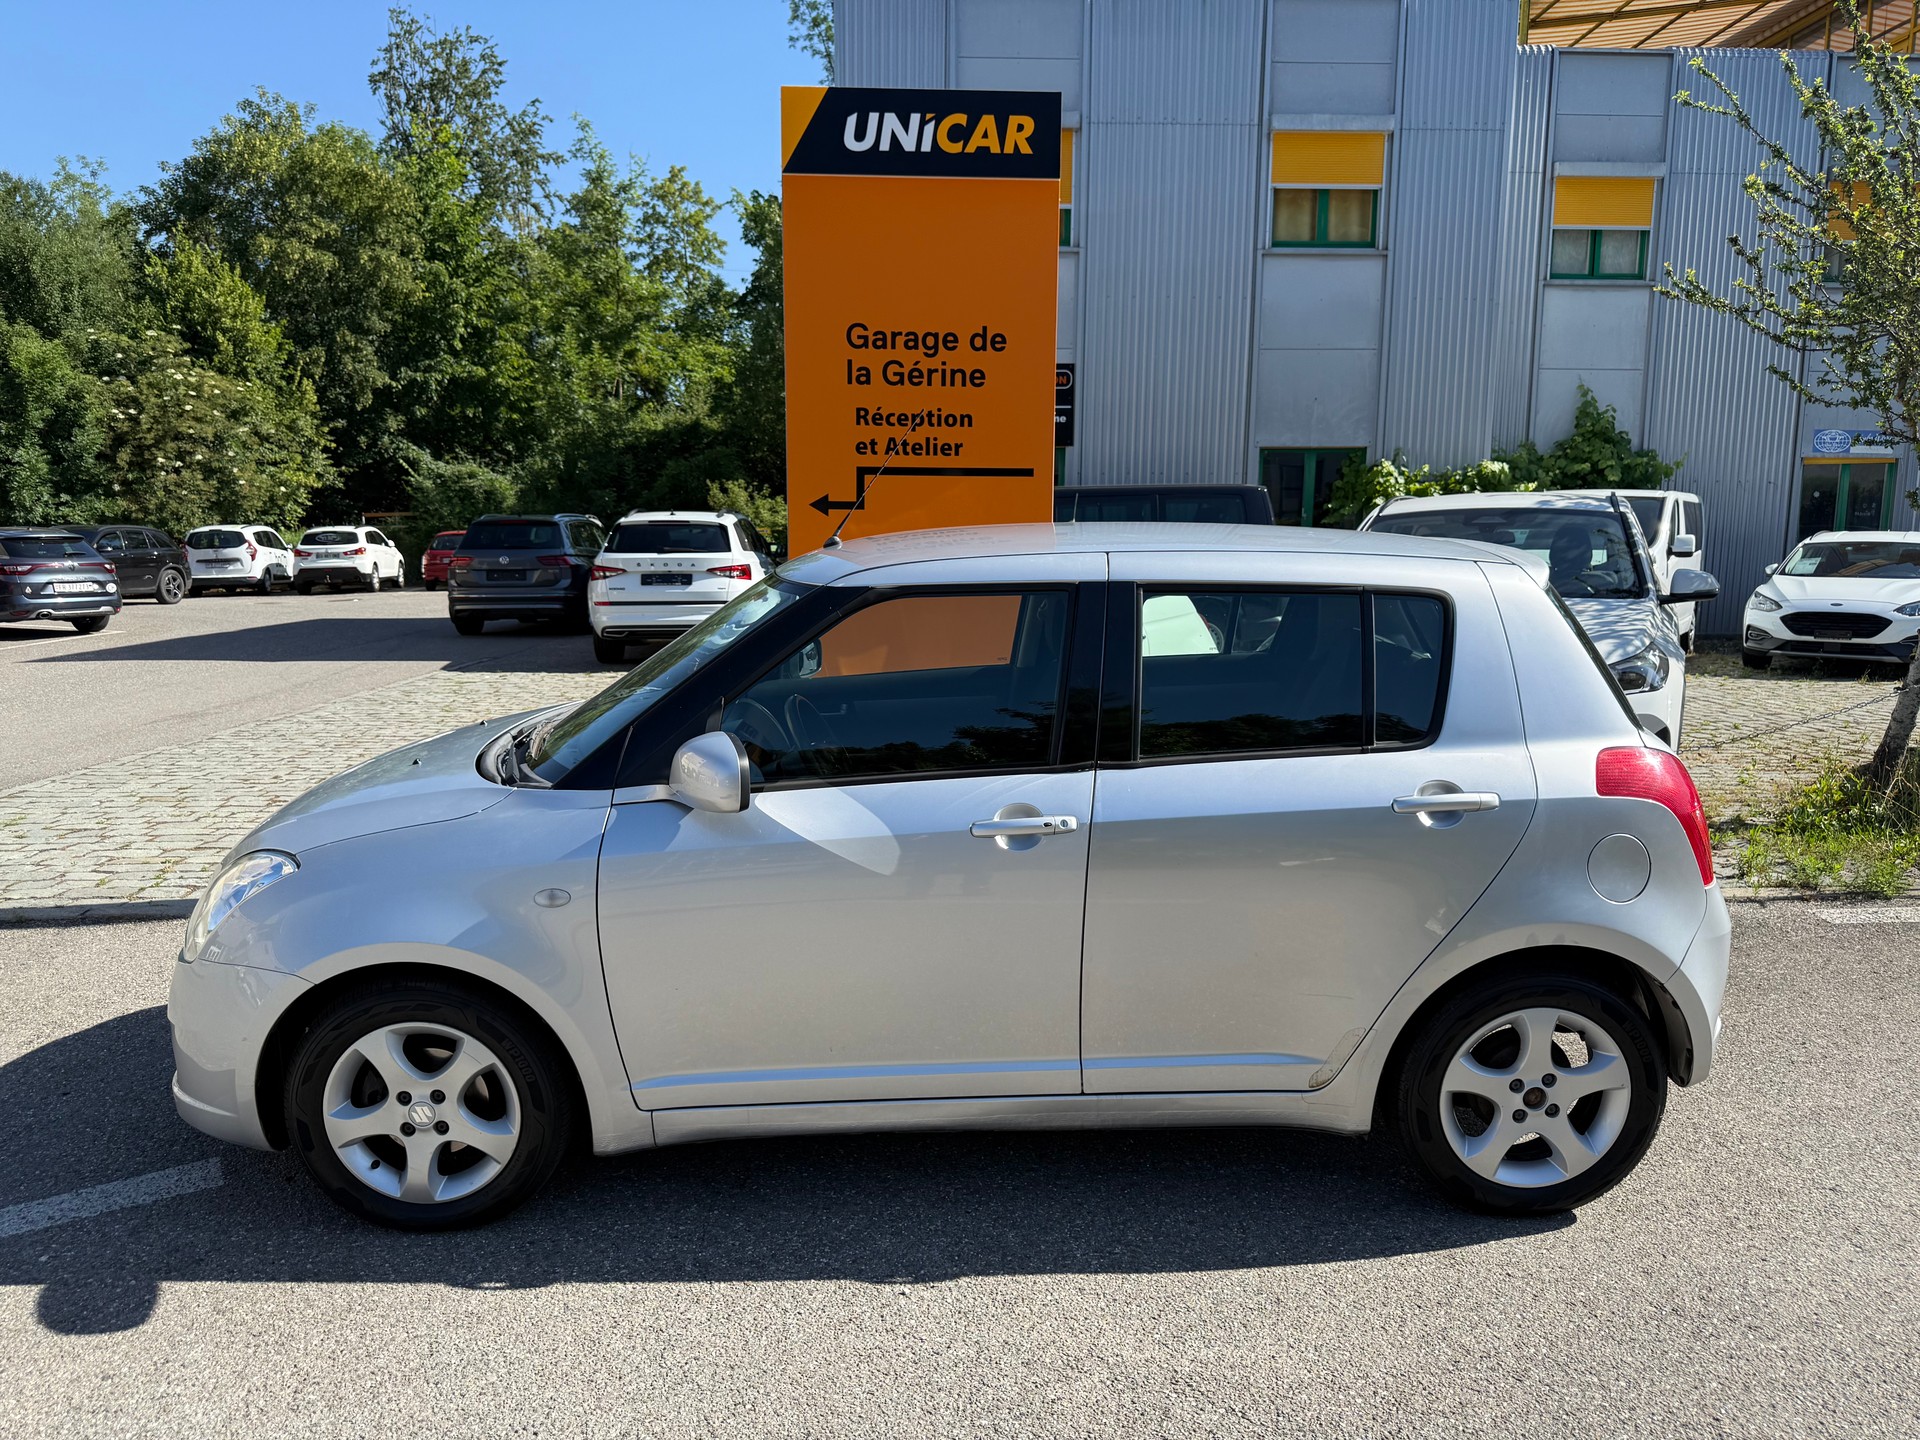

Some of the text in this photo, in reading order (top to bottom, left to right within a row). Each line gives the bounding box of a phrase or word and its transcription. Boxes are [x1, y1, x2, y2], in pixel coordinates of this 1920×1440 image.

[846, 323, 1008, 358] Garage de
[847, 359, 987, 388] la Gérine
[855, 407, 973, 432] Réception
[855, 437, 963, 457] et Atelier
[500, 1038, 537, 1082] WP1000
